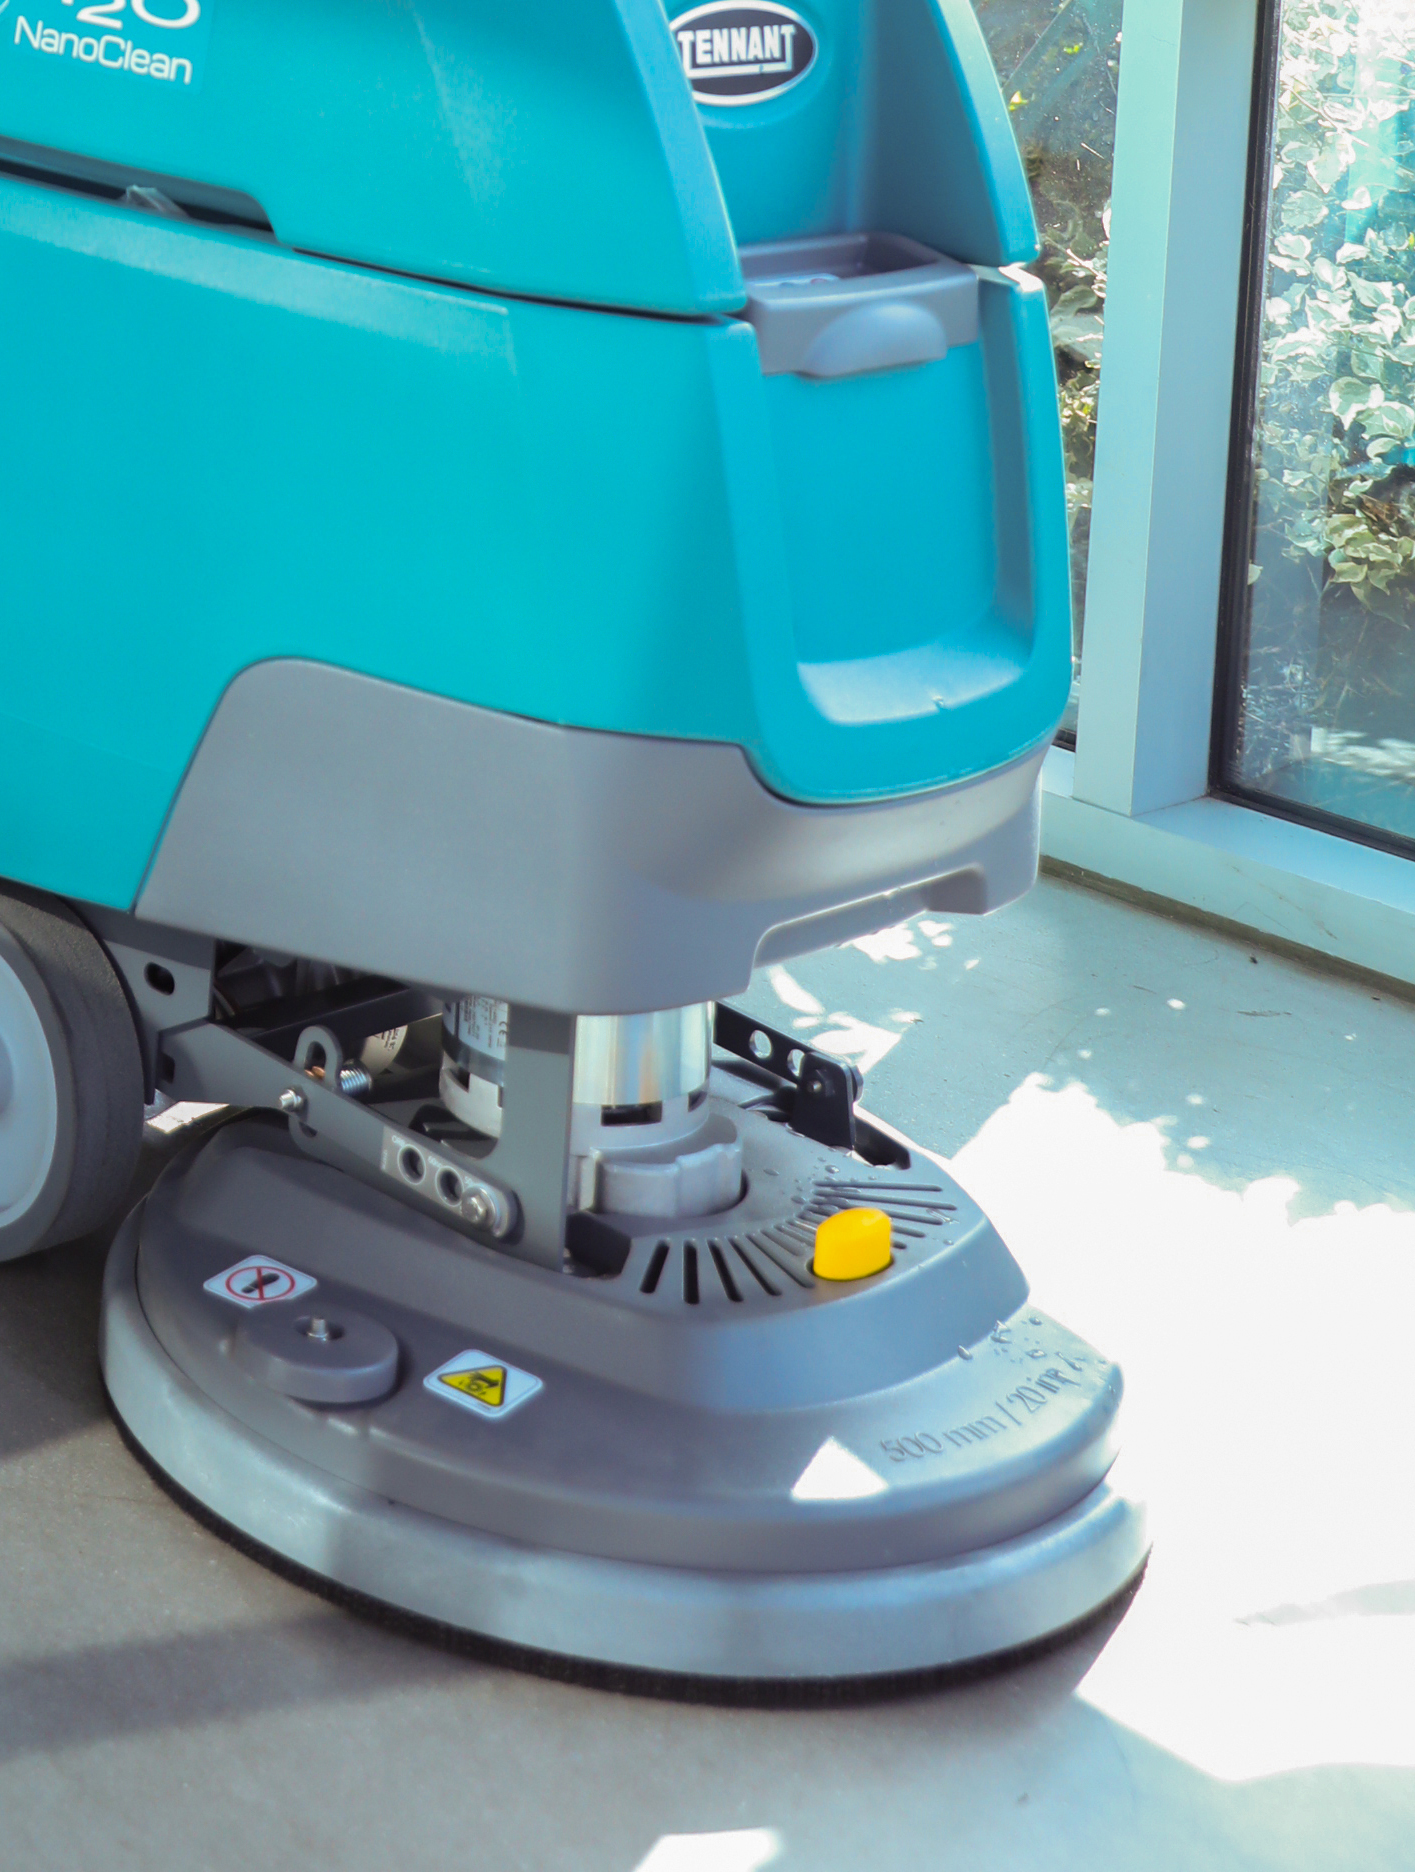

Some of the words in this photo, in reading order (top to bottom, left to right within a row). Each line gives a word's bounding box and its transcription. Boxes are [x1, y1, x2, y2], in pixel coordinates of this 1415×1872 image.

[13, 14, 193, 85] NanoClean
[676, 24, 797, 79] TENNANT
[879, 1431, 944, 1463] 500
[942, 1415, 1008, 1448] mm
[1005, 1385, 1048, 1414] 20
